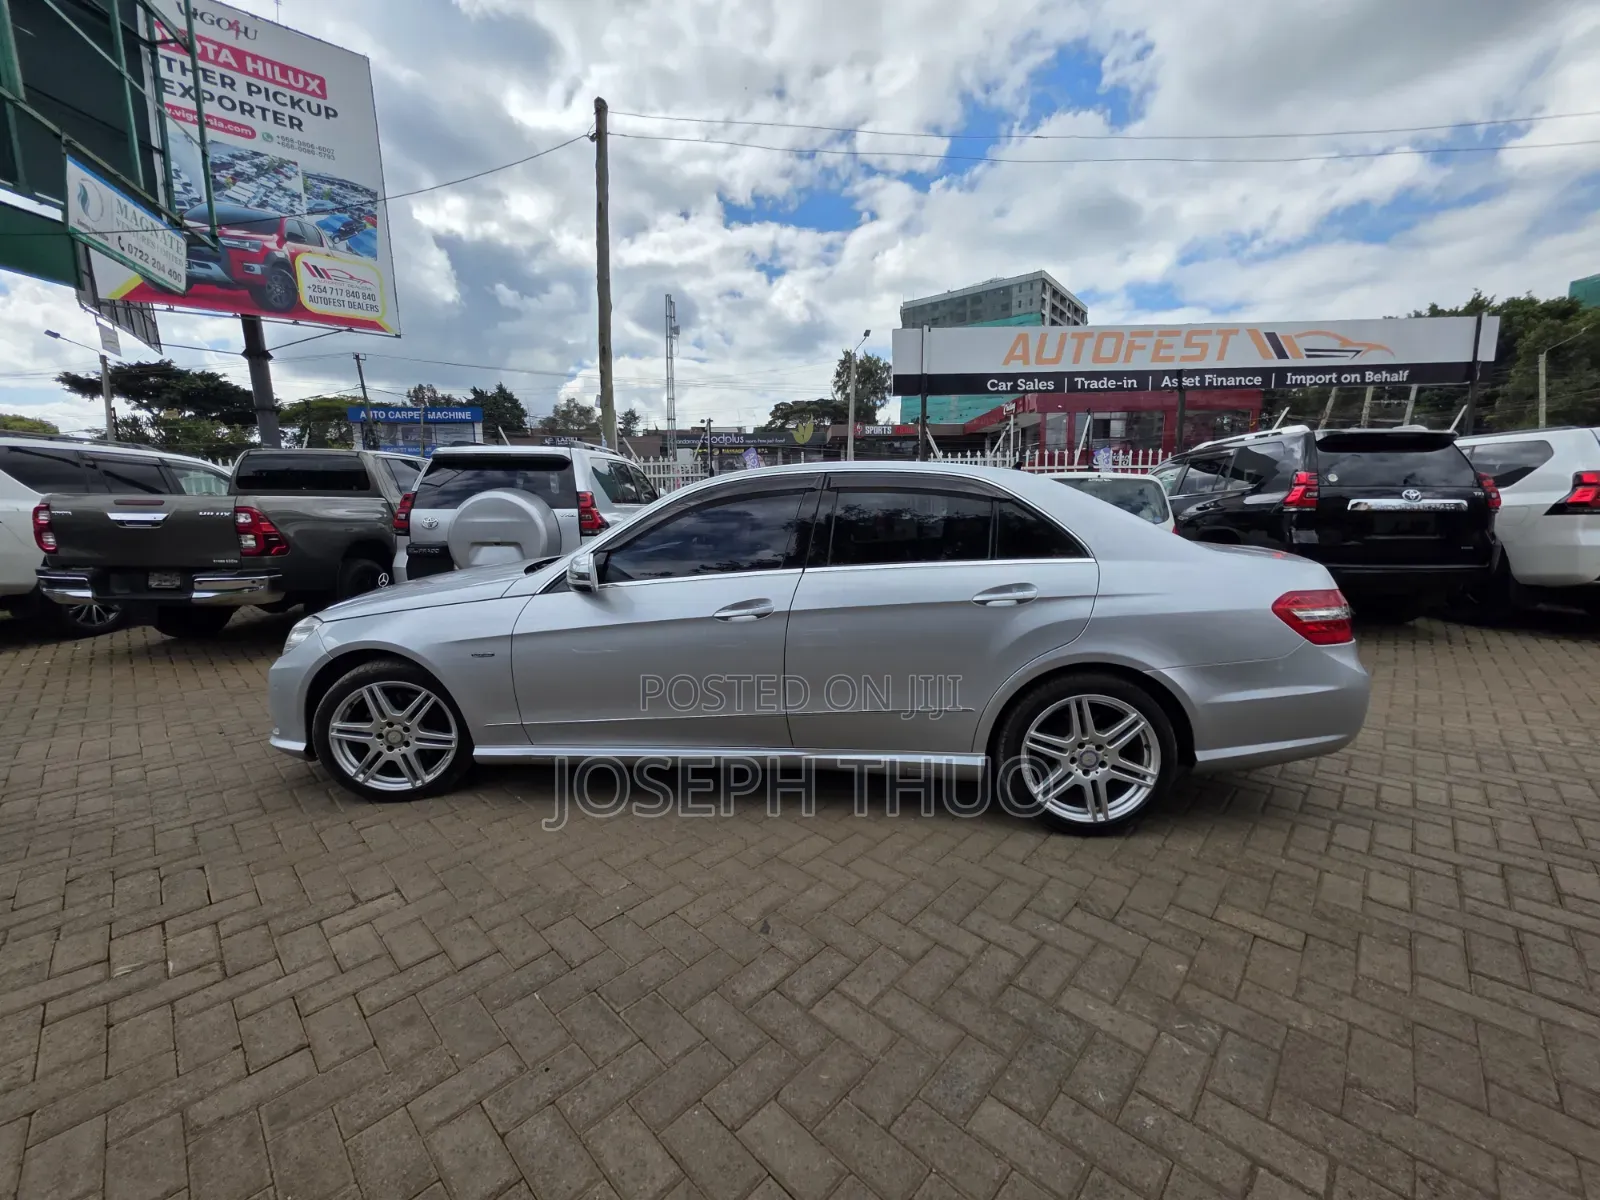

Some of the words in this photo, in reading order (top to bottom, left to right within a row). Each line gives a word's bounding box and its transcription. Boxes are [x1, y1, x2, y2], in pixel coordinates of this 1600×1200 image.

[245, 56, 323, 95] HILUX
[246, 81, 339, 120] PICKUP
[116, 198, 183, 256] MAGNATE
[128, 243, 149, 265] 0722
[151, 257, 165, 274] 204
[168, 267, 182, 283] 400
[307, 284, 327, 294] +254
[329, 287, 344, 297] 717
[346, 290, 360, 299] 840
[362, 292, 376, 302] 840
[308, 295, 345, 308] AUTOFEST
[348, 301, 379, 313] DEALERS
[1003, 328, 1240, 367] AUTOFEST
[987, 379, 1013, 391] Car
[1017, 378, 1055, 390] Sales
[1074, 376, 1138, 389] Trade-in
[1161, 374, 1200, 388] Asset
[1204, 374, 1263, 387] Finance
[1286, 372, 1337, 386] Import
[1341, 373, 1361, 383] on
[1365, 370, 1409, 382] Behalf
[865, 426, 892, 434] SPORTS
